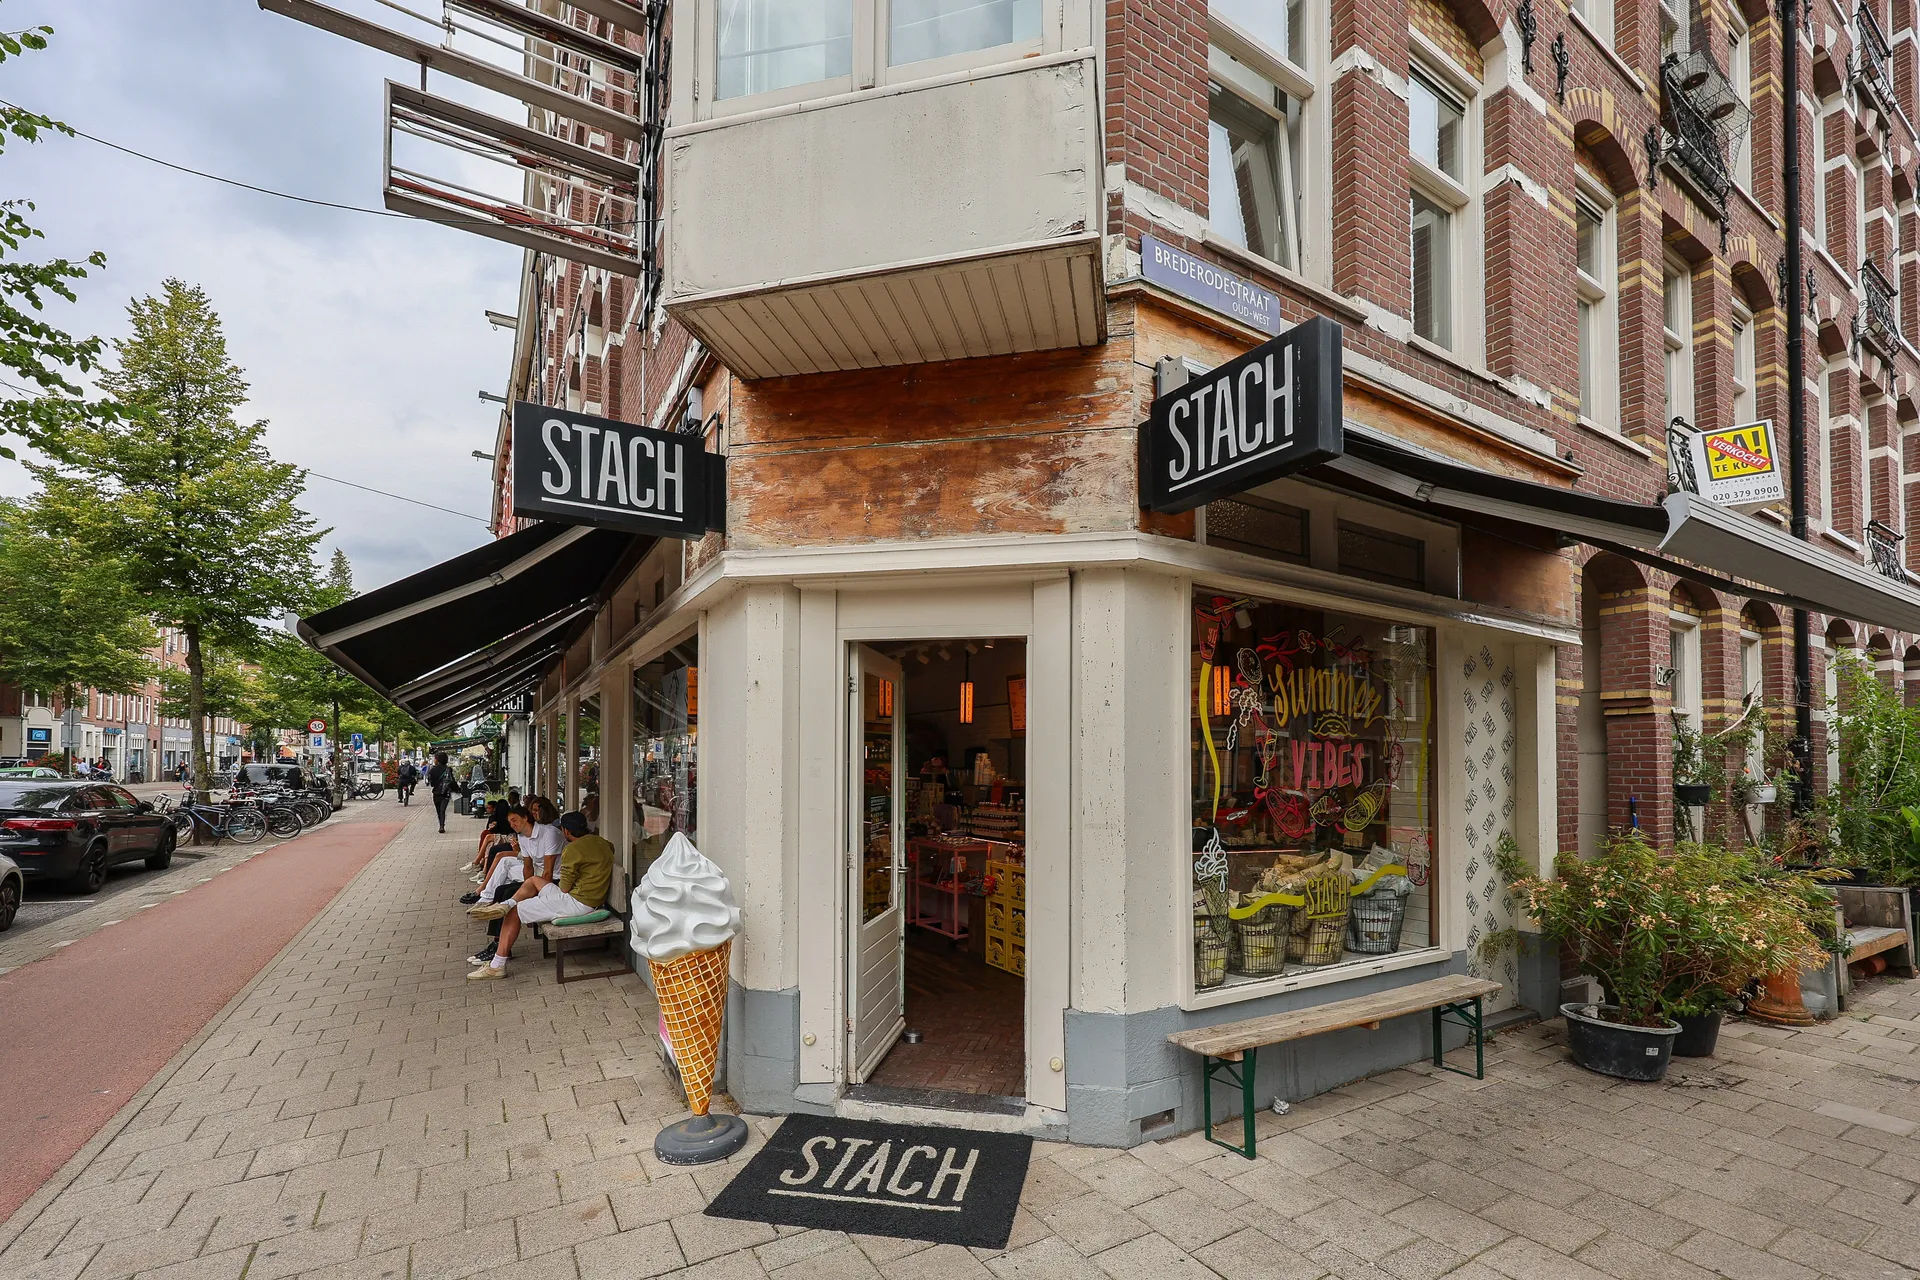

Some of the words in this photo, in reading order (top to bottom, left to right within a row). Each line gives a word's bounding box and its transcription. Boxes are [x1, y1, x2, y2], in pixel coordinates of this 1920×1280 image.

[1154, 245, 1270, 312] BREDERODESTRAAT
[1231, 301, 1271, 327] OUD-WEST
[1168, 343, 1293, 481] STACH
[541, 418, 684, 513] STACH
[1712, 439, 1766, 466] VERKOCHT
[1714, 464, 1728, 473] TE
[1712, 492, 1731, 501] 020
[1733, 489, 1751, 499] 379
[1754, 485, 1779, 496] 0900
[1267, 663, 1383, 729] Summer
[1291, 739, 1365, 791] VIBES
[1306, 875, 1348, 915] STACH
[779, 1135, 980, 1202] STACH
